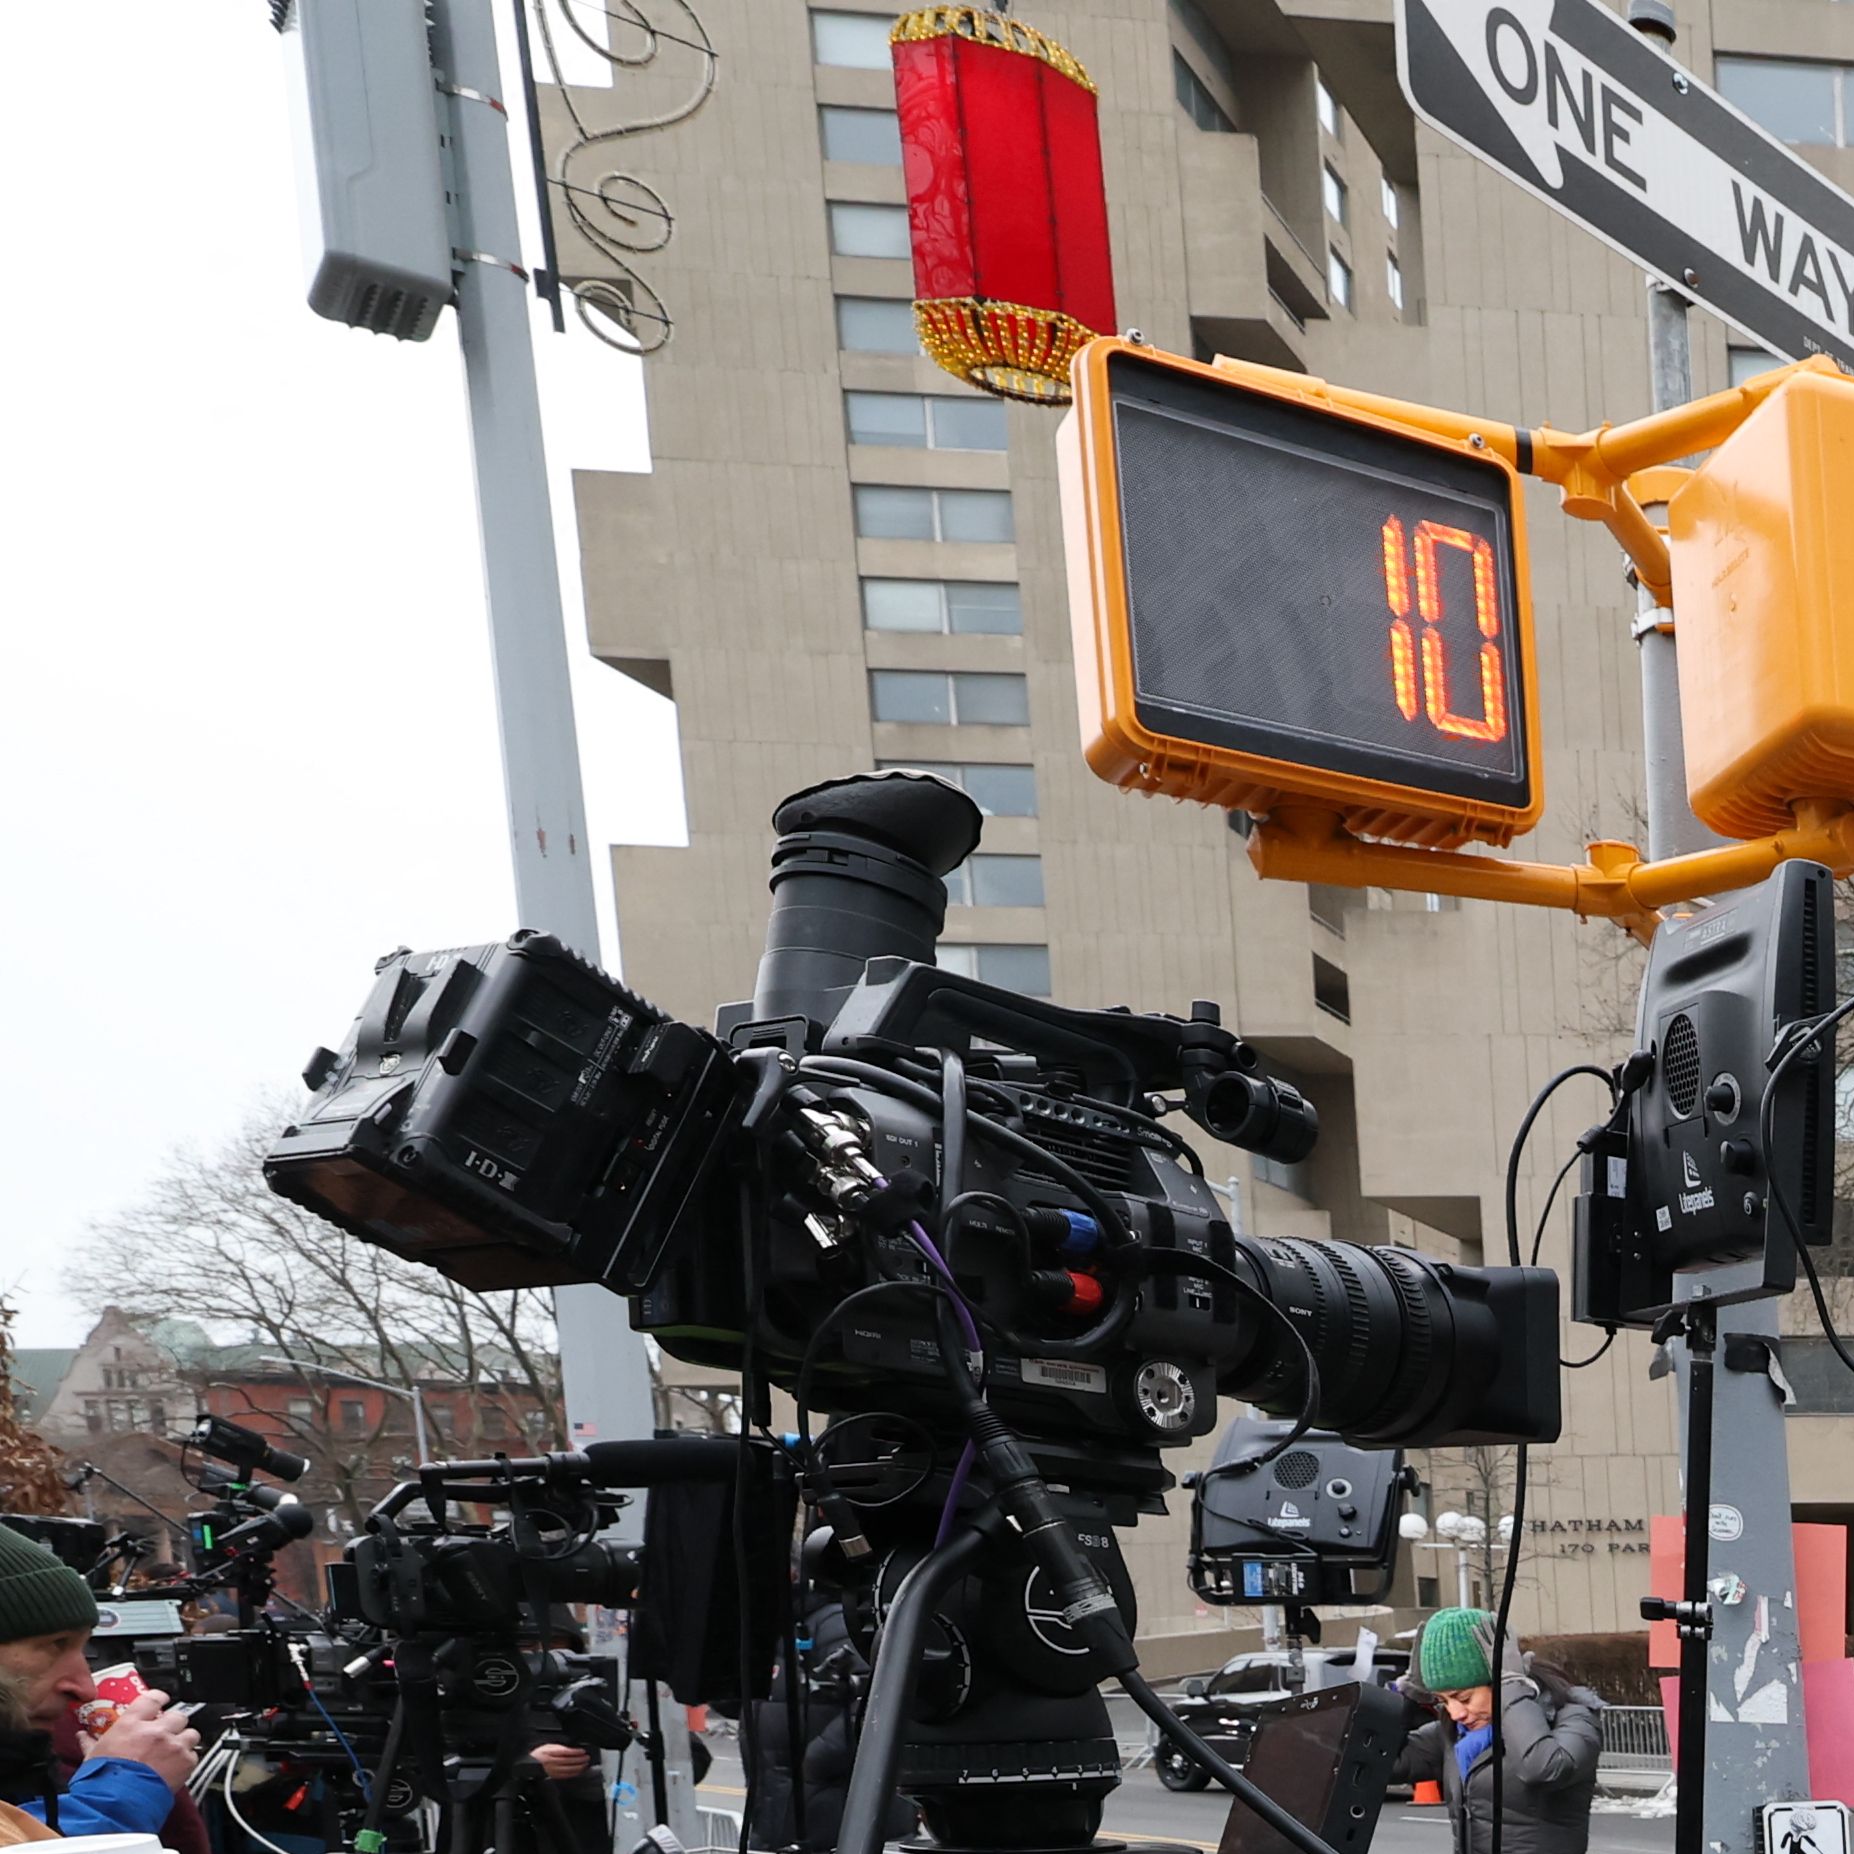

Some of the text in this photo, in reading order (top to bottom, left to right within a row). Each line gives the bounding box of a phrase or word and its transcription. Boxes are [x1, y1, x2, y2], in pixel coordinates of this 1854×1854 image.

[1484, 7, 1647, 192] ONE
[1382, 513, 1505, 742] 10
[1678, 1186, 1715, 1216] Litepanels
[1288, 1305, 1313, 1317] SONY
[1530, 1518, 1645, 1533] HATHAM
[1559, 1542, 1651, 1554] 170 PAR
